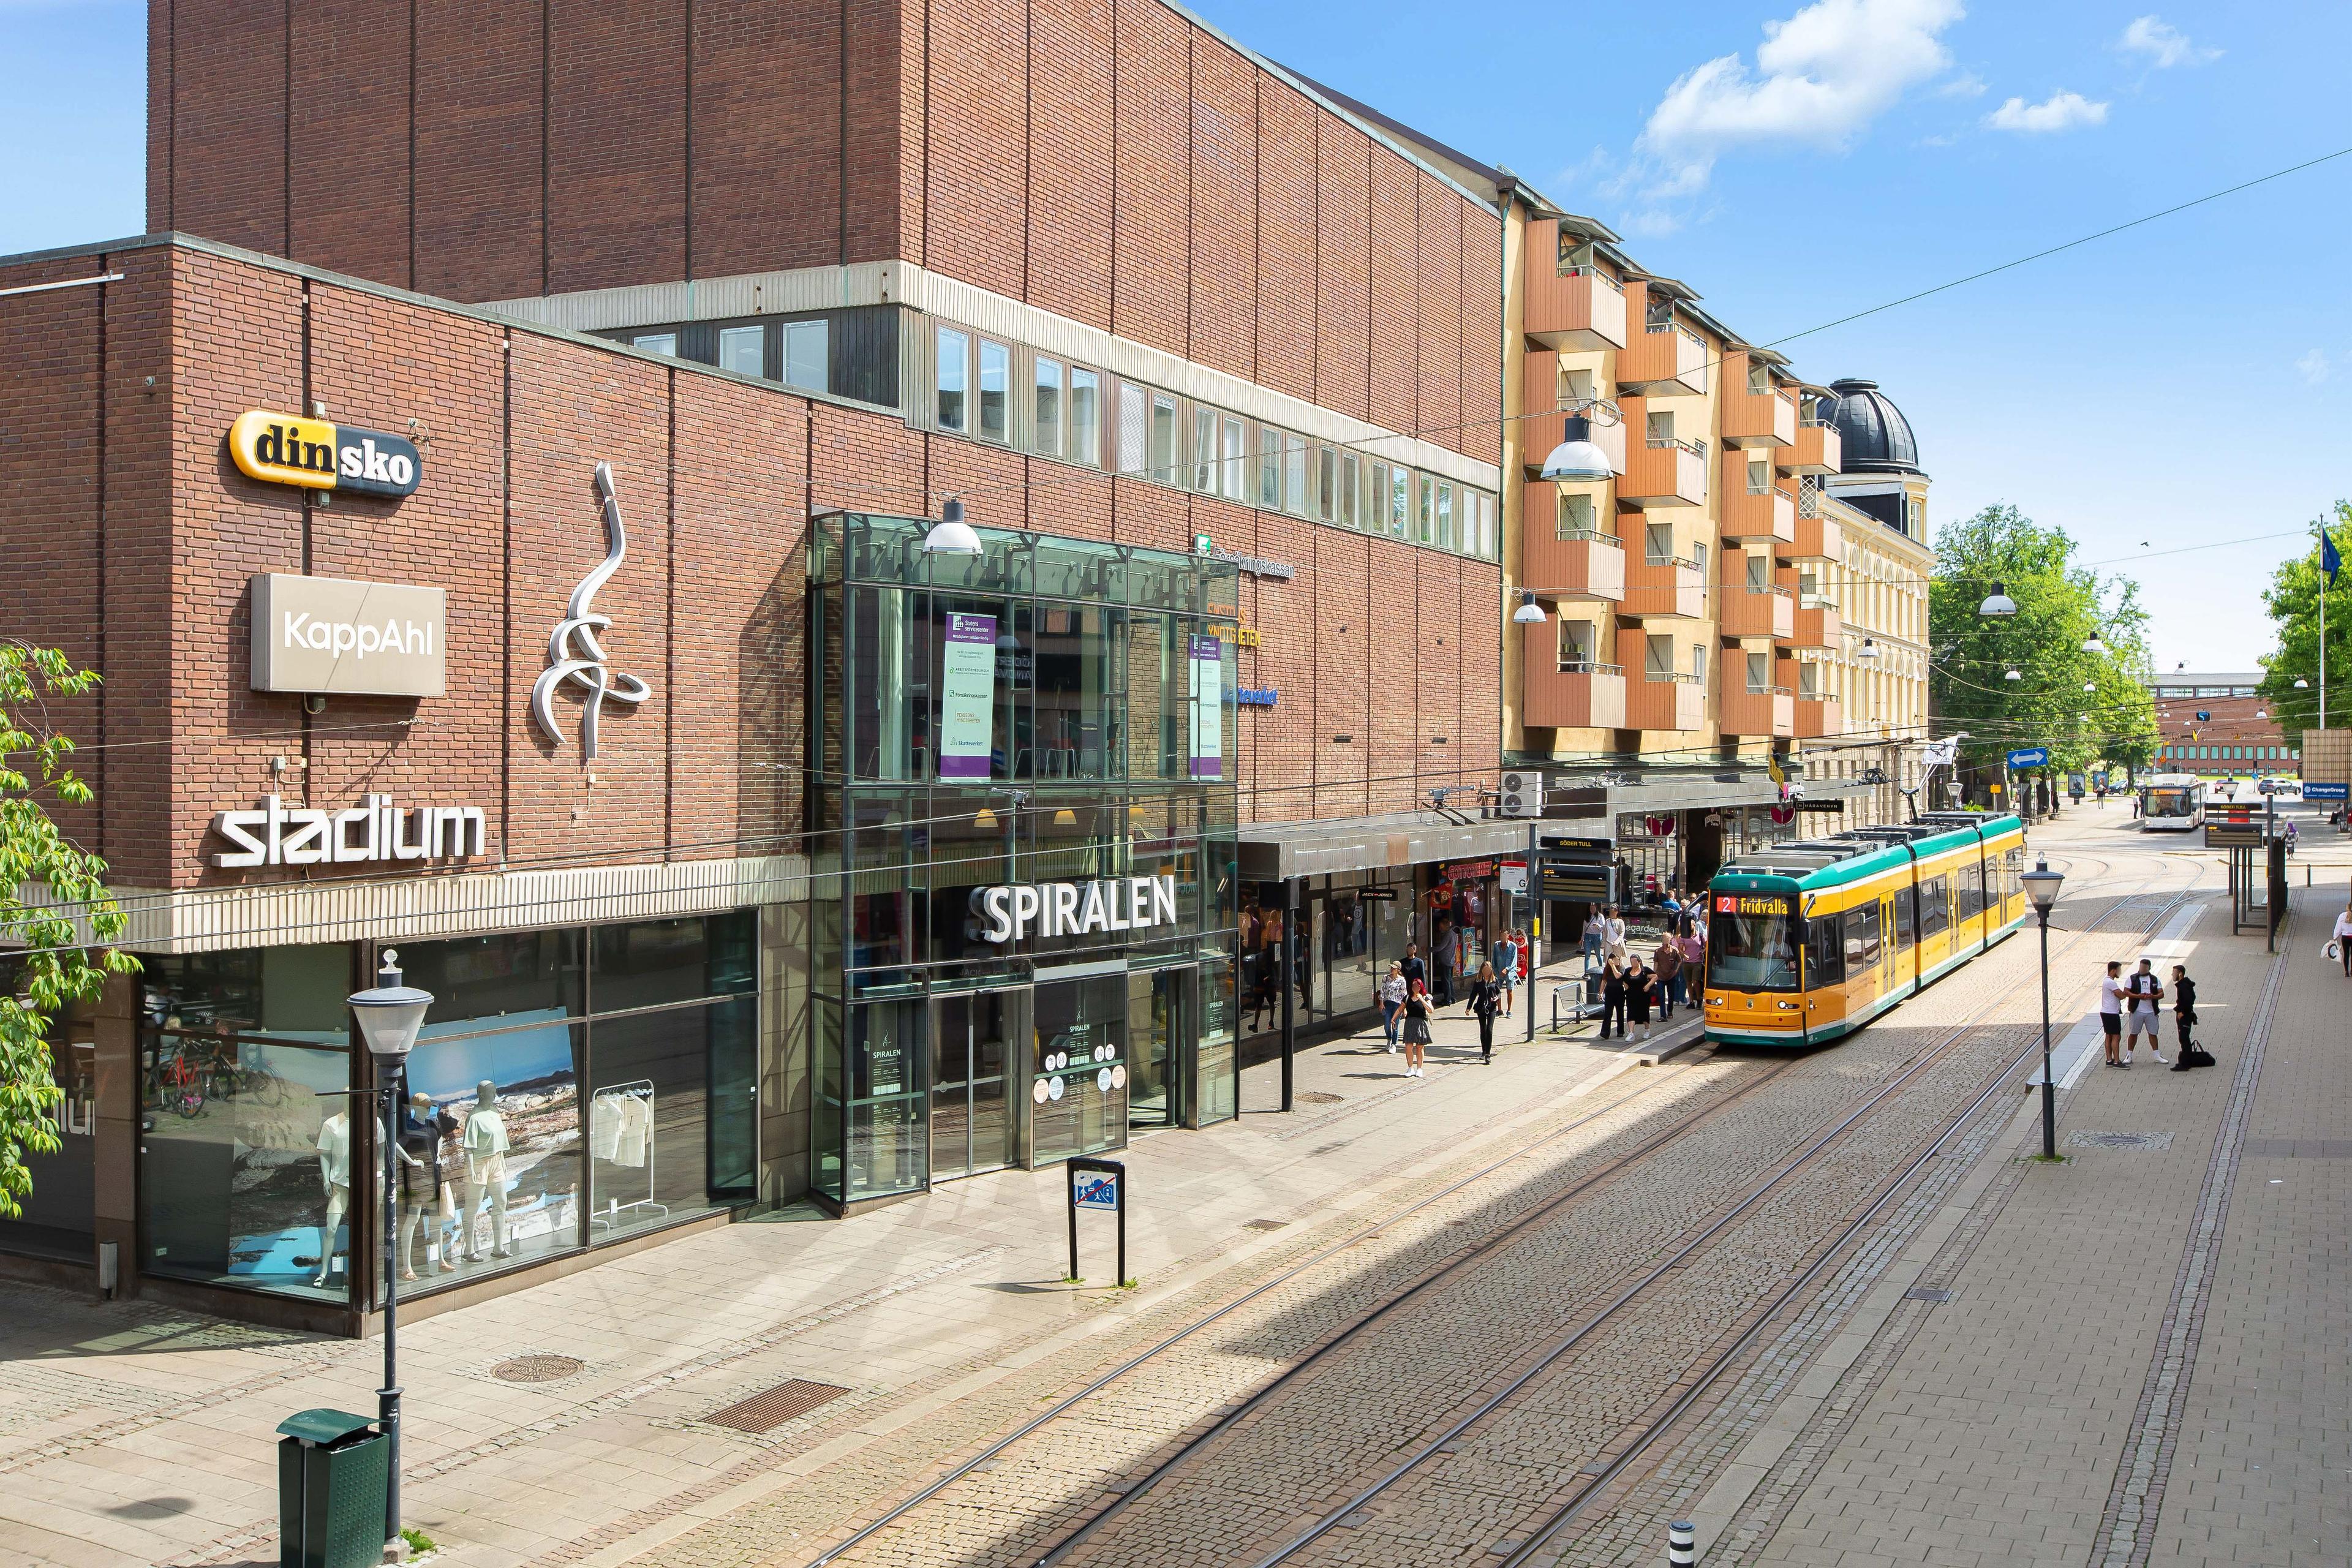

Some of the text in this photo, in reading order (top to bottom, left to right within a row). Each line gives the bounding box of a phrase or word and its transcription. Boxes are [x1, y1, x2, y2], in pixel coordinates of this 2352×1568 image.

[284, 611, 432, 660] KappAhl
[212, 794, 484, 868] stadium
[1519, 879, 1526, 888] G
[984, 875, 1176, 943] SPIRALEN
[1722, 897, 1788, 914] 2 Fridvalla
[1626, 925, 1659, 935] egarden
[1069, 1023, 1090, 1033] SPIRALEN
[873, 1049, 901, 1059] SPIRALEN
